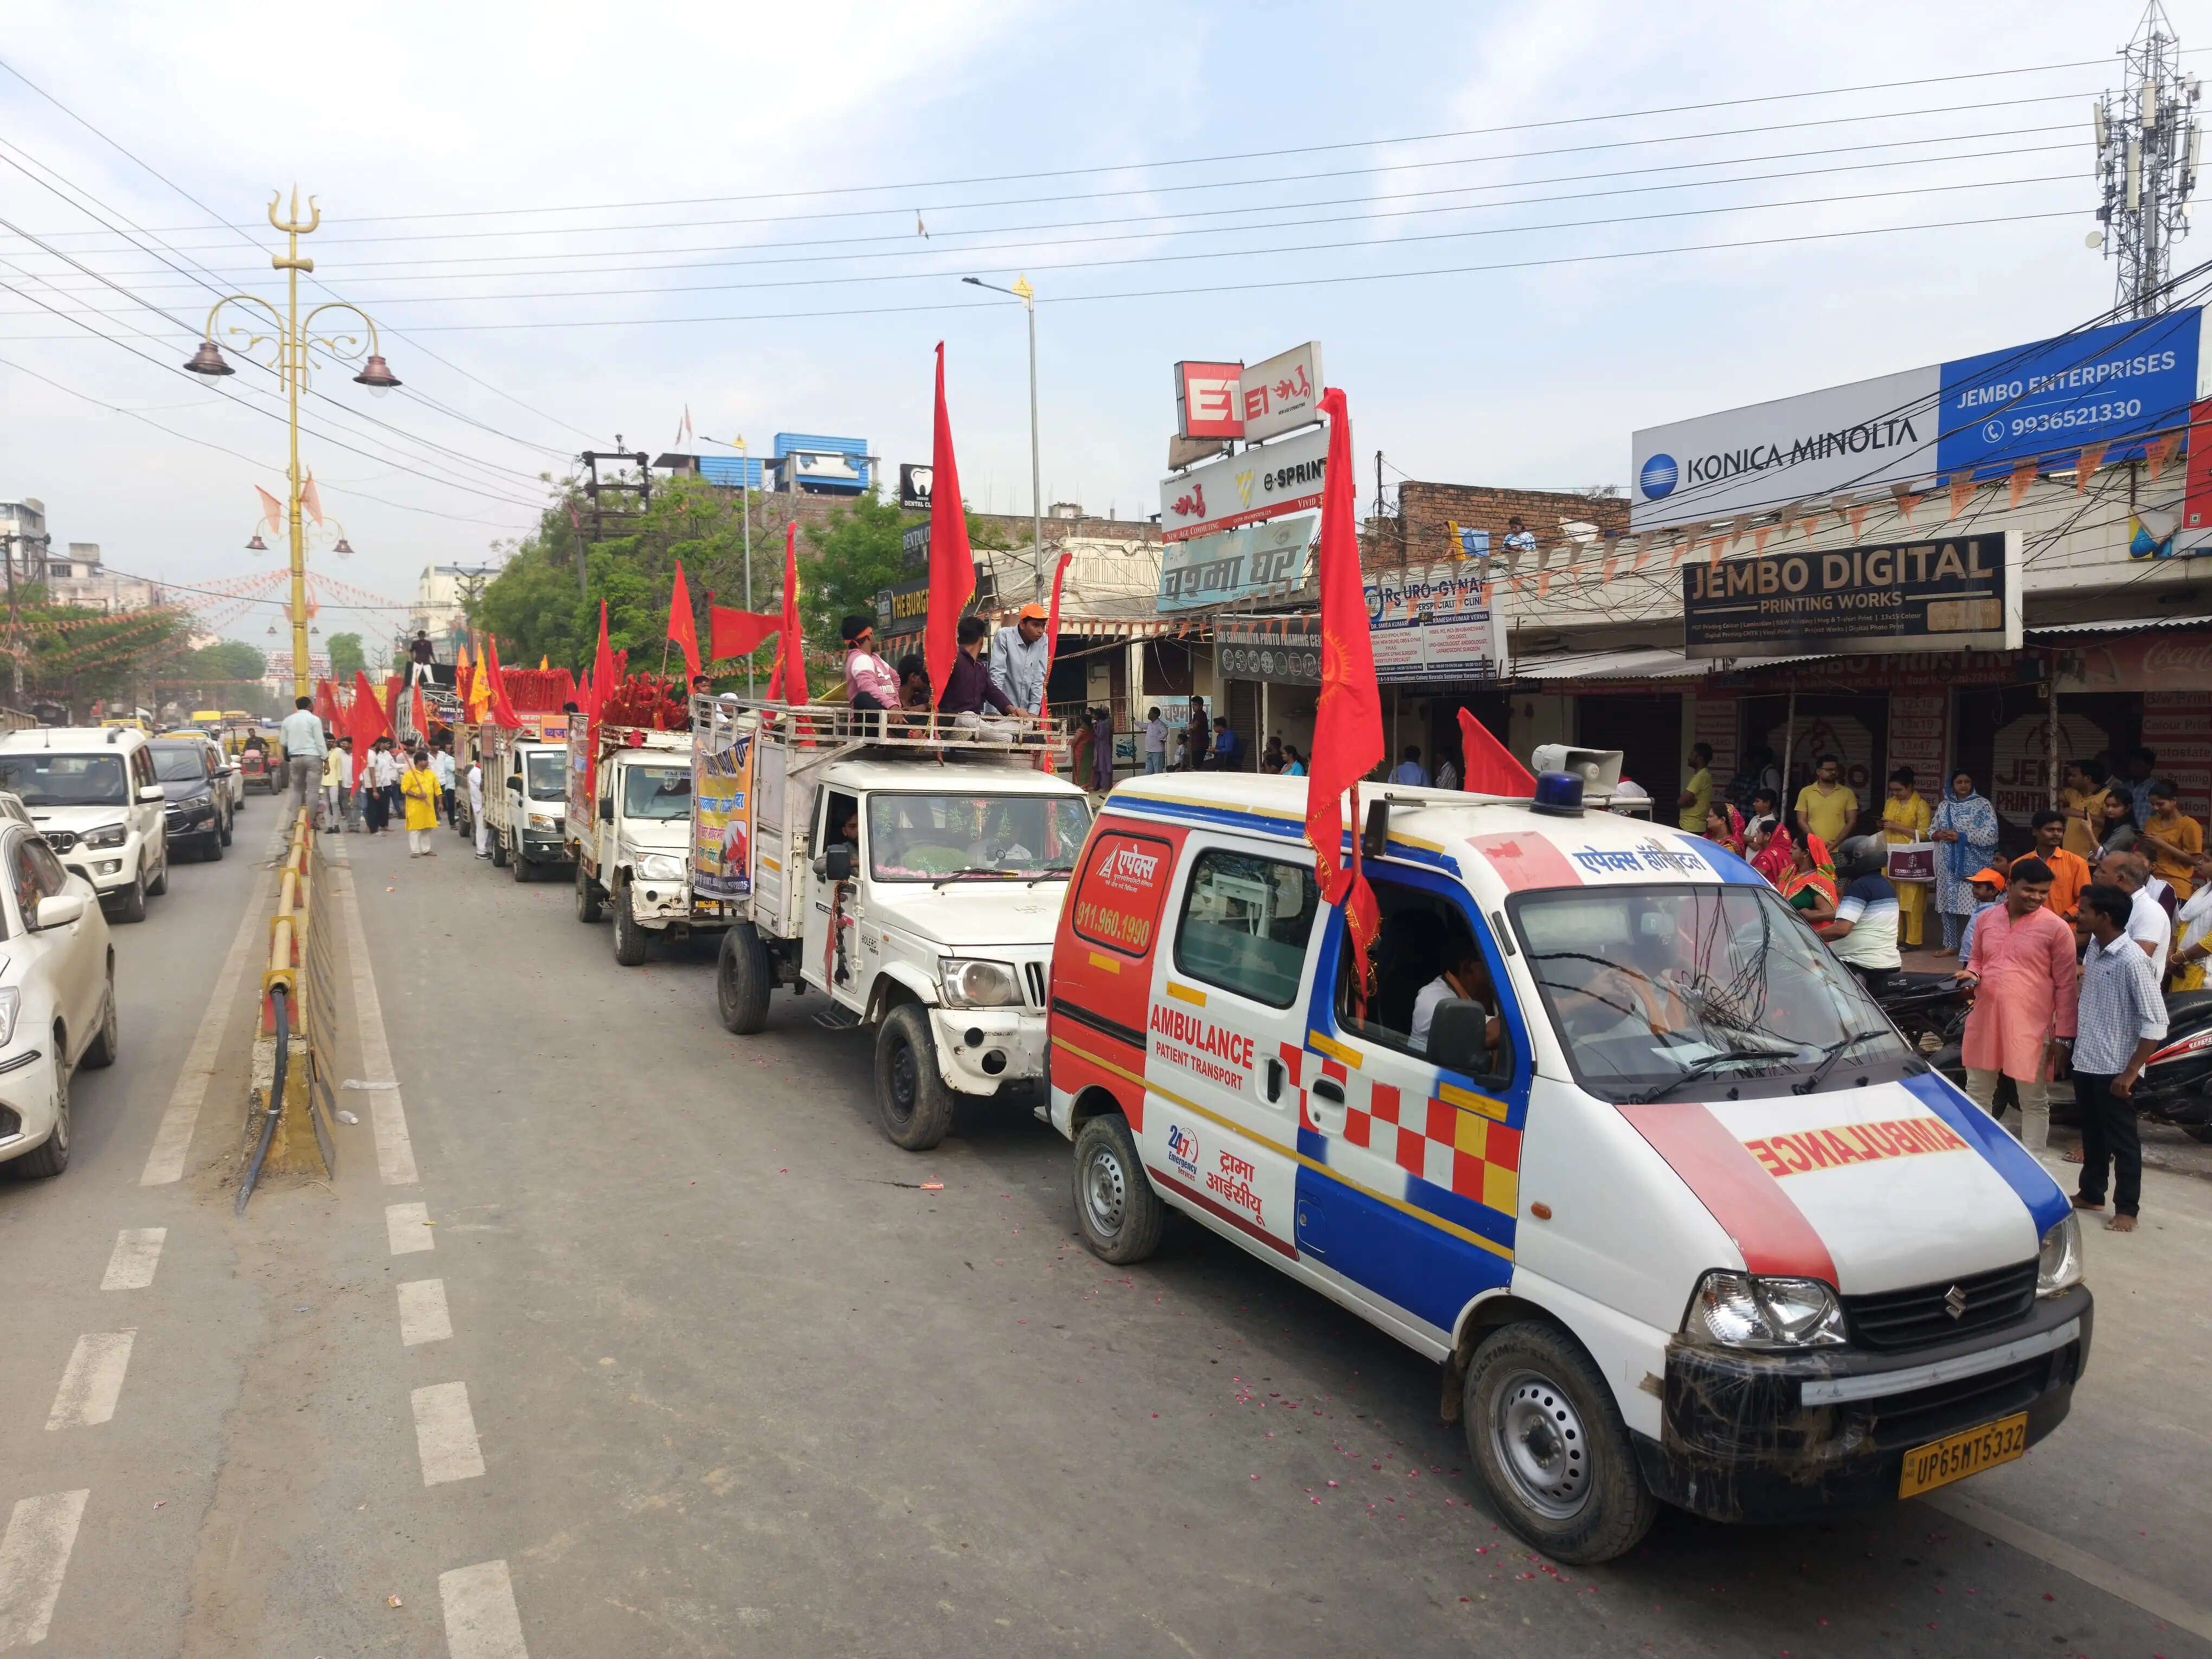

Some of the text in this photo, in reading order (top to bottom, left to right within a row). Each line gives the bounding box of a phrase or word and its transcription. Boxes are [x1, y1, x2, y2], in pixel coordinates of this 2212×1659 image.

[1957, 351, 2175, 409] JEMBO ENTERPRISES
[2011, 399, 2141, 436] 9936521330
[1688, 418, 1918, 483] KONICA MINOLTA
[1297, 498, 1316, 509] VIVID
[903, 529, 924, 550] DENTAL
[1167, 522, 1219, 541] NEW AGE COMMUTING
[1164, 544, 1301, 600] चश्मा घर
[1692, 542, 1994, 600] JEMBO DIGITAL
[893, 594, 906, 619] THE
[1464, 596, 1482, 606] CLINI
[1760, 591, 1903, 614] PRINTING WORKS
[1217, 631, 1226, 643] SRI
[1260, 632, 1280, 646] PHOTO
[2144, 720, 2181, 731] Colour
[1921, 762, 1939, 770] Card
[1913, 780, 1938, 788] ouge
[2167, 773, 2209, 785] Printing
[2177, 801, 2208, 812] ation
[1117, 844, 1159, 880] एपेक्स
[1571, 845, 1645, 874] एपेक्स
[1077, 901, 1149, 947] 911.960.1990
[861, 935, 877, 949] BOLERO
[1150, 1004, 1254, 1070] AMBULANCE
[1156, 1040, 1243, 1090] PATIENT TRANSPORT
[1168, 1150, 1197, 1175] Emergency
[1177, 1166, 1195, 1182] Services
[1219, 1149, 1255, 1183] ट्रामा
[1205, 1171, 1265, 1227] आईसीयू
[1917, 1423, 2024, 1485] UP65MT5332
